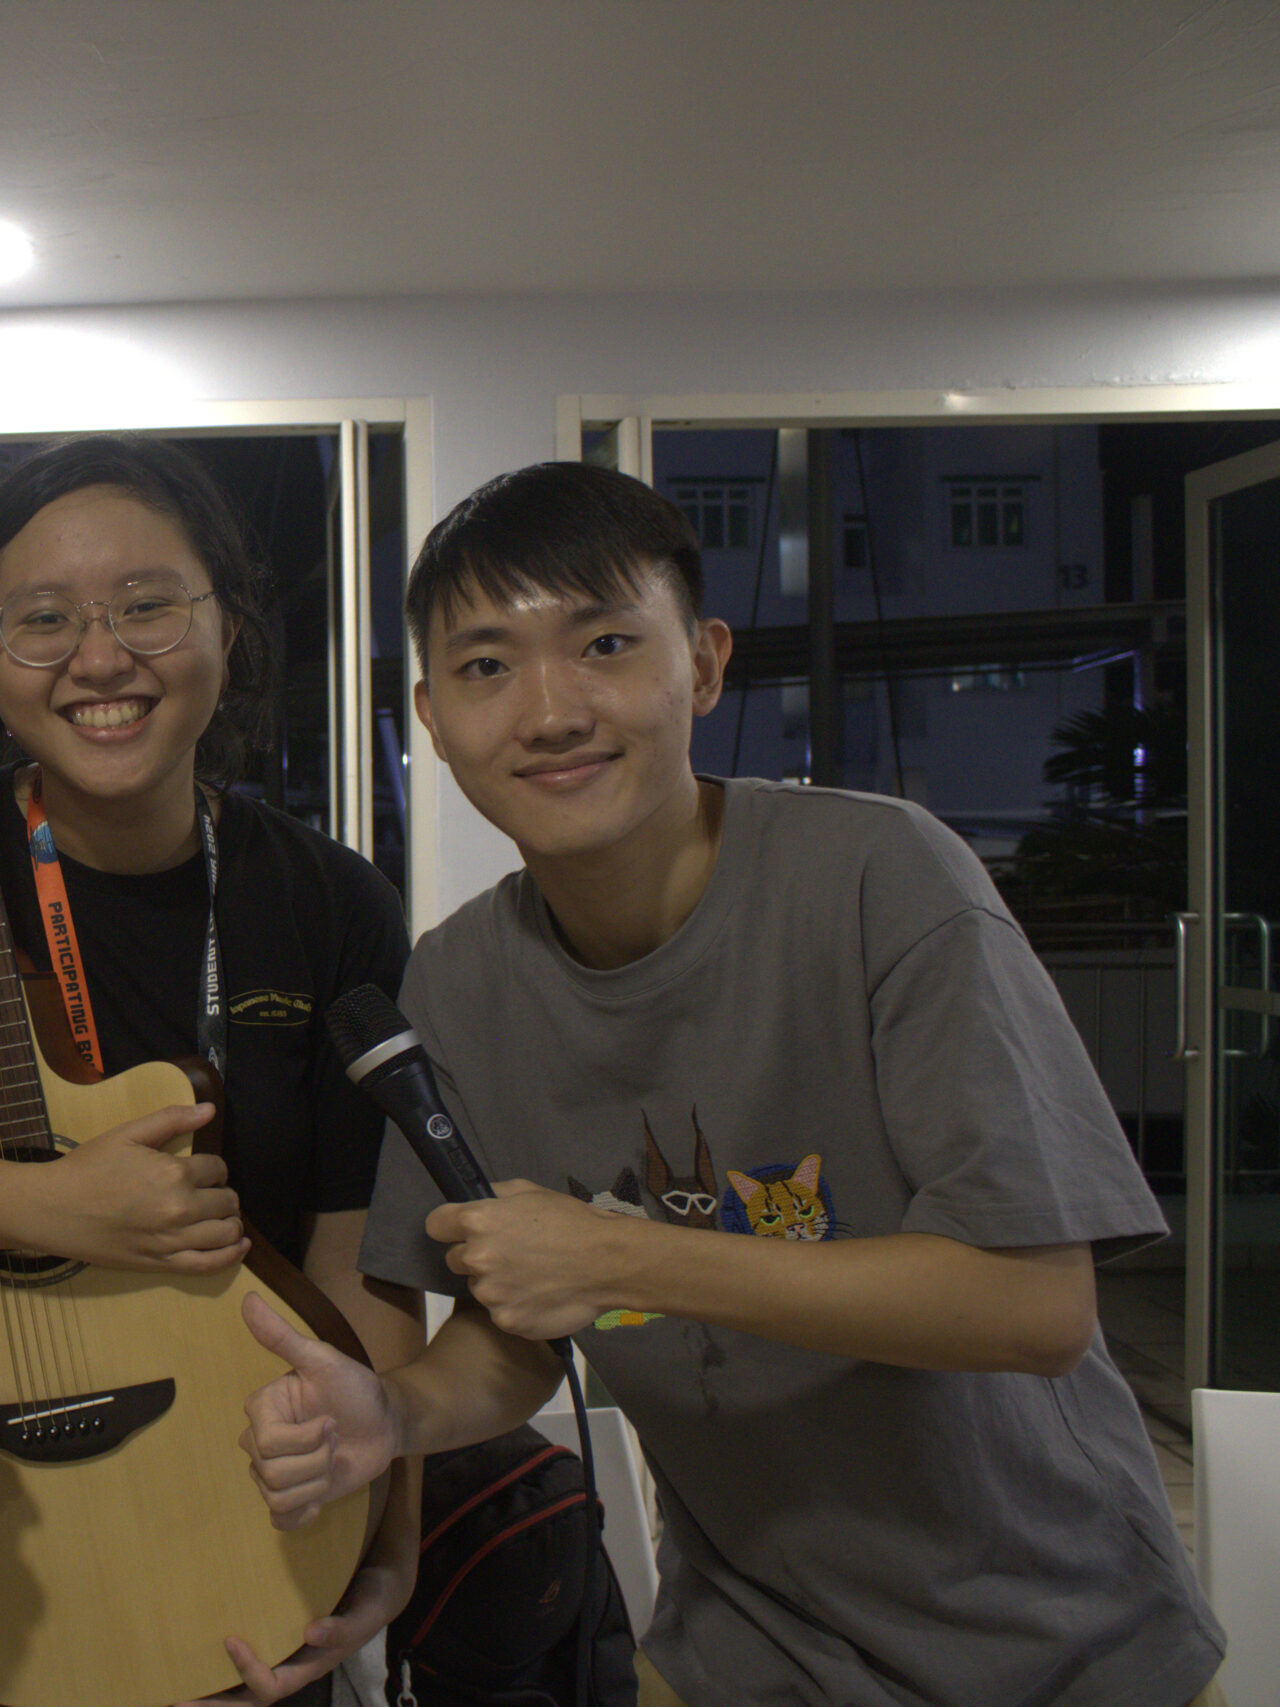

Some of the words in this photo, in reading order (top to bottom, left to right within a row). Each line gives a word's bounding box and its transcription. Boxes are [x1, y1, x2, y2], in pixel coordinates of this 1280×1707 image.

[203, 813, 217, 855] 2024
[48, 901, 89, 1035] PARTICIPATING
[206, 938, 221, 1017] STUDENT
